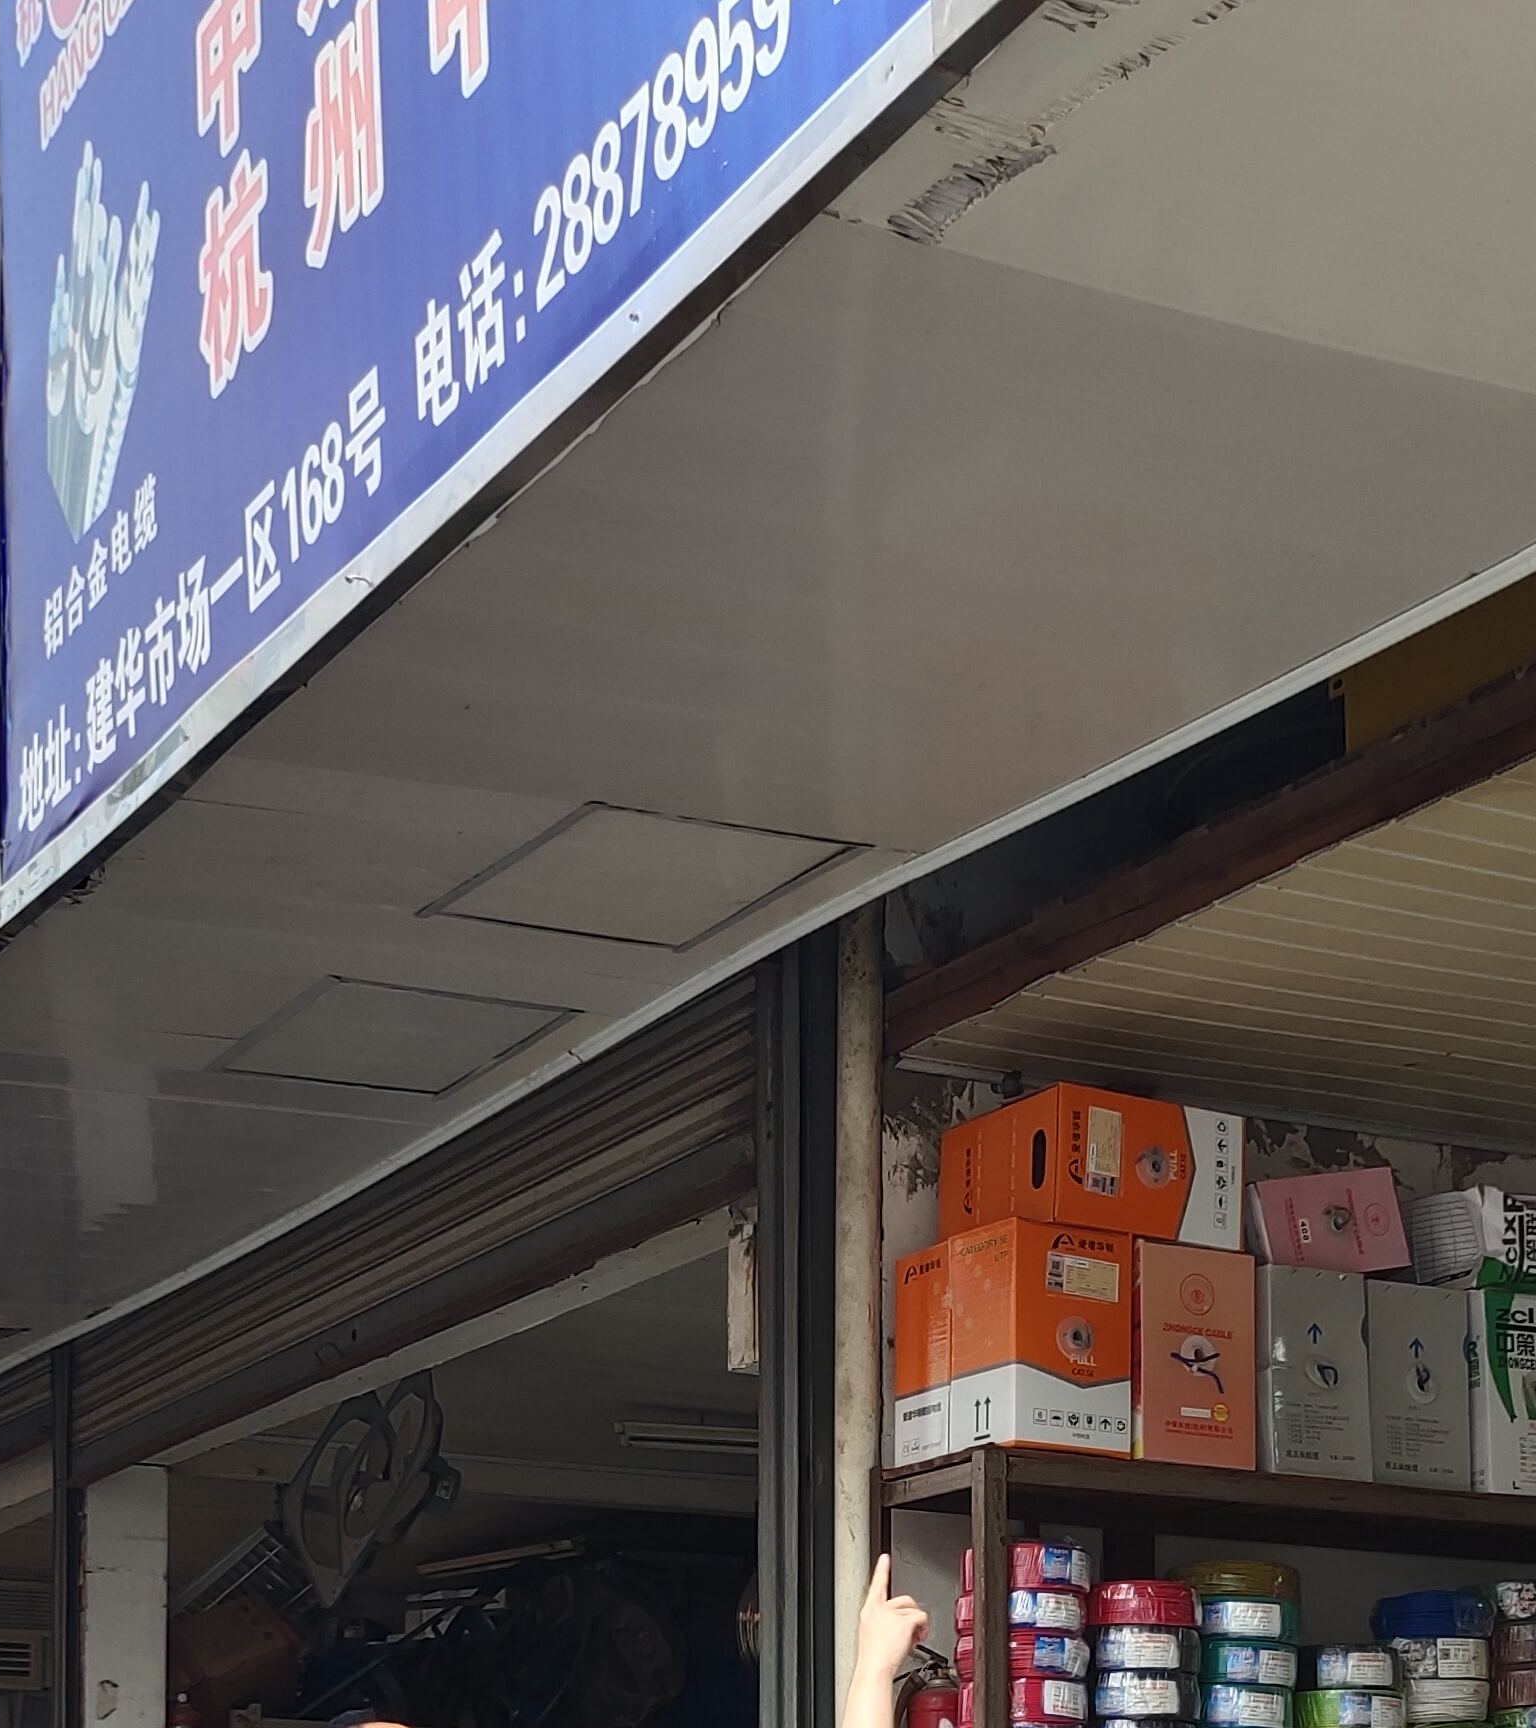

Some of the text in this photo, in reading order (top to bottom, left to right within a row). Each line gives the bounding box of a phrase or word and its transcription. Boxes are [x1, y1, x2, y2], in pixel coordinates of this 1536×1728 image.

[18, 366, 386, 833] 地址：建华市场一区168号
[43, 473, 157, 660] 铝合金电缆
